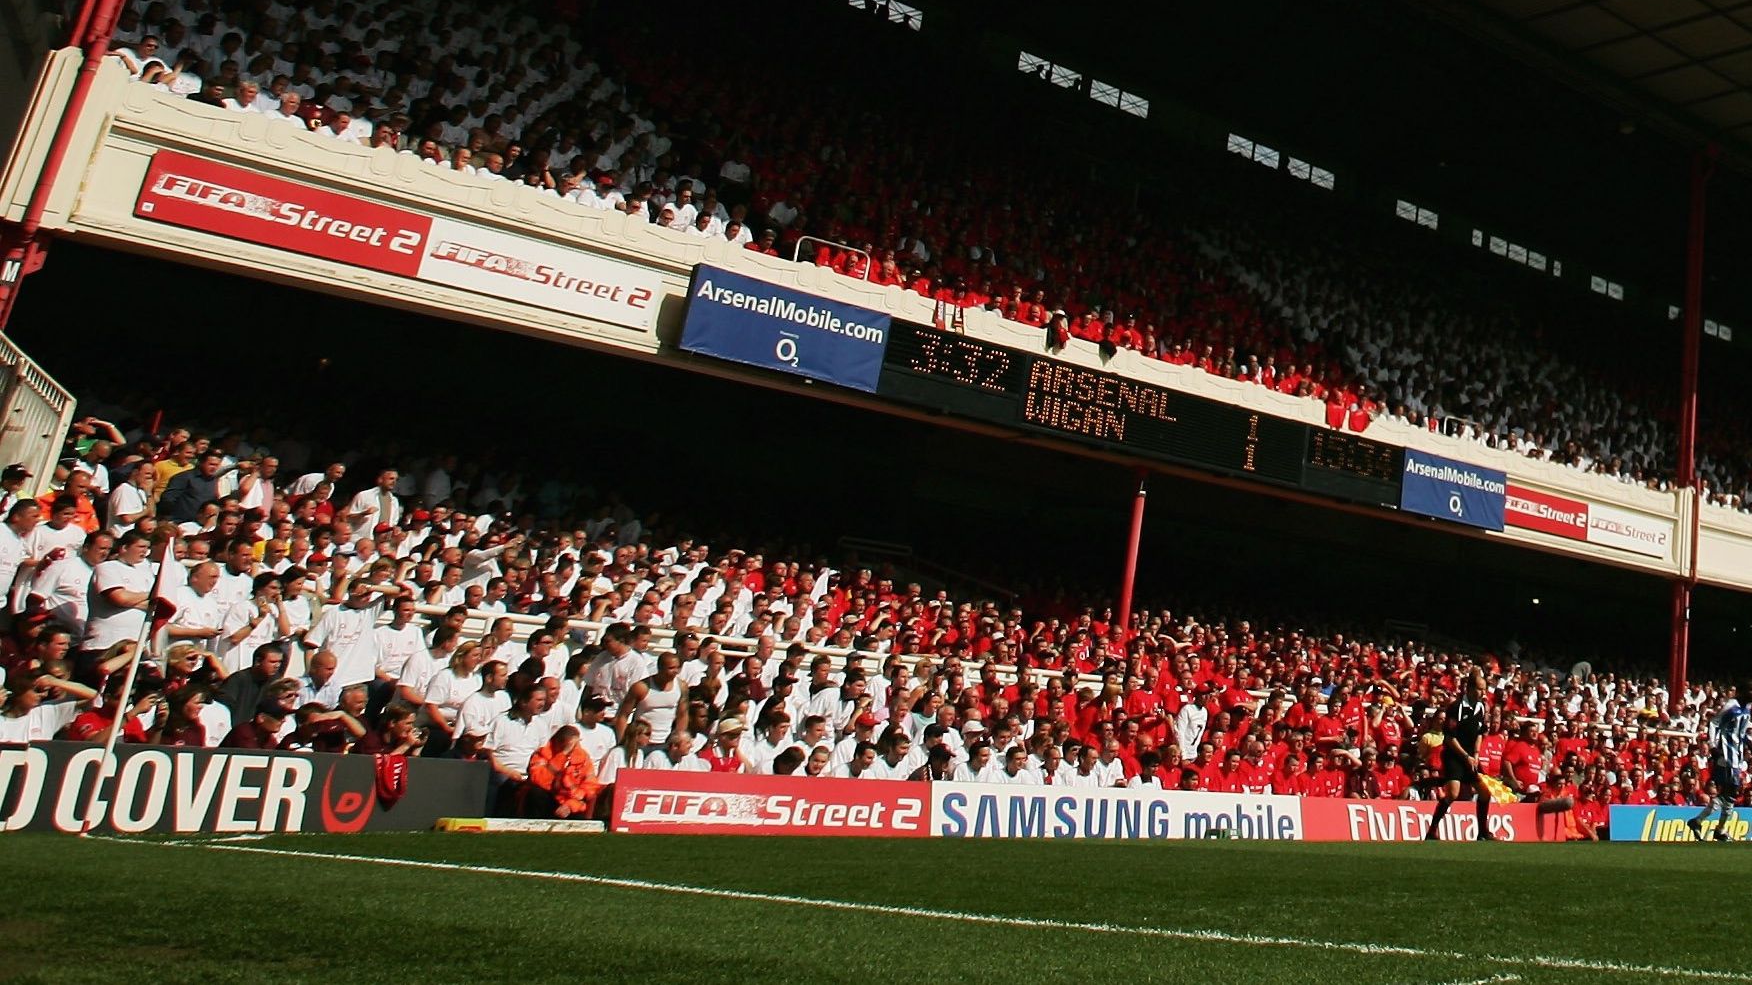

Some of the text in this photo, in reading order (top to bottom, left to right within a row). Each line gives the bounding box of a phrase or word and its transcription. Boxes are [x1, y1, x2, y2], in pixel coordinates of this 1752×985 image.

[158, 175, 421, 254] FIFA Street 2
[437, 242, 652, 309] FIFA Street 2
[698, 279, 883, 344] ArsenalMobile.com
[910, 330, 1011, 392] 3:32
[1029, 359, 1259, 442] ARSENAL 1
[1025, 391, 1256, 472] WIGAN 1
[1405, 458, 1505, 495] ArsenalMobile.com
[1538, 504, 1576, 525] Street
[1575, 513, 1587, 528] 2
[1624, 525, 1657, 543] Street
[1657, 532, 1667, 545] 2
[1191, 724, 1203, 746] 7
[54, 748, 314, 832] COVER
[632, 792, 922, 831] FIFA Street 2
[942, 792, 1295, 840] SAMSUNG mobile
[1348, 804, 1515, 841] Fly Emiraes
[1641, 808, 1749, 841] Luczde
